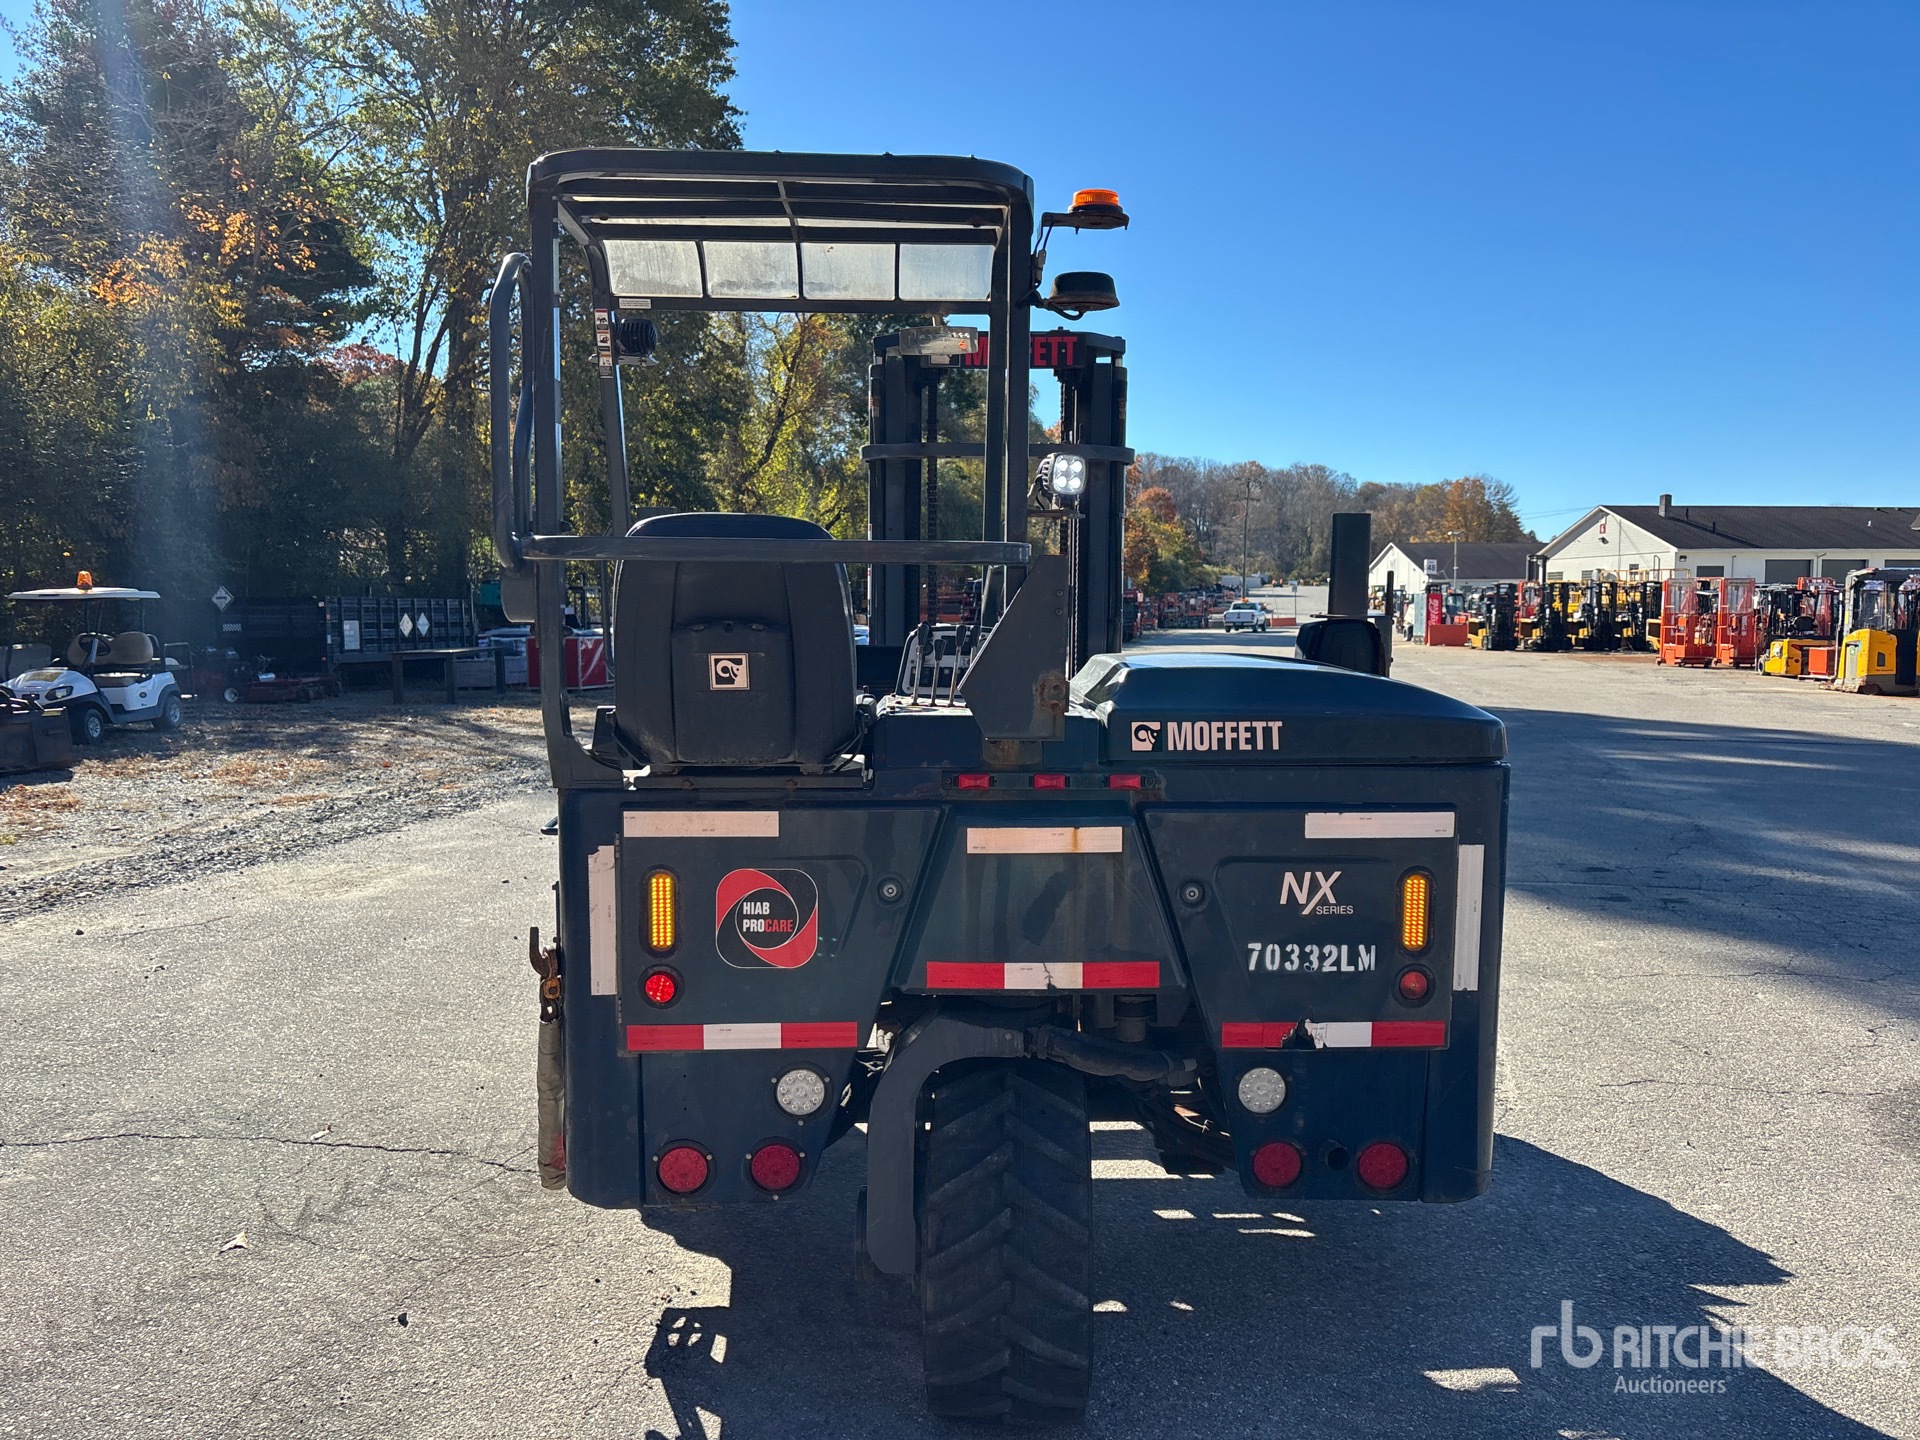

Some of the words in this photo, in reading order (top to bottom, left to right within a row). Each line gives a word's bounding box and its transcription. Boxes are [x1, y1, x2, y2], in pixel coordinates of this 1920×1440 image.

[964, 335, 1078, 366] METT
[1167, 720, 1283, 751] MOFFETT
[1279, 871, 1342, 915] NX
[742, 901, 770, 915] HIAB
[1315, 905, 1354, 915] SERIES
[742, 919, 794, 932] PROCARE
[1247, 943, 1377, 972] 70332LM
